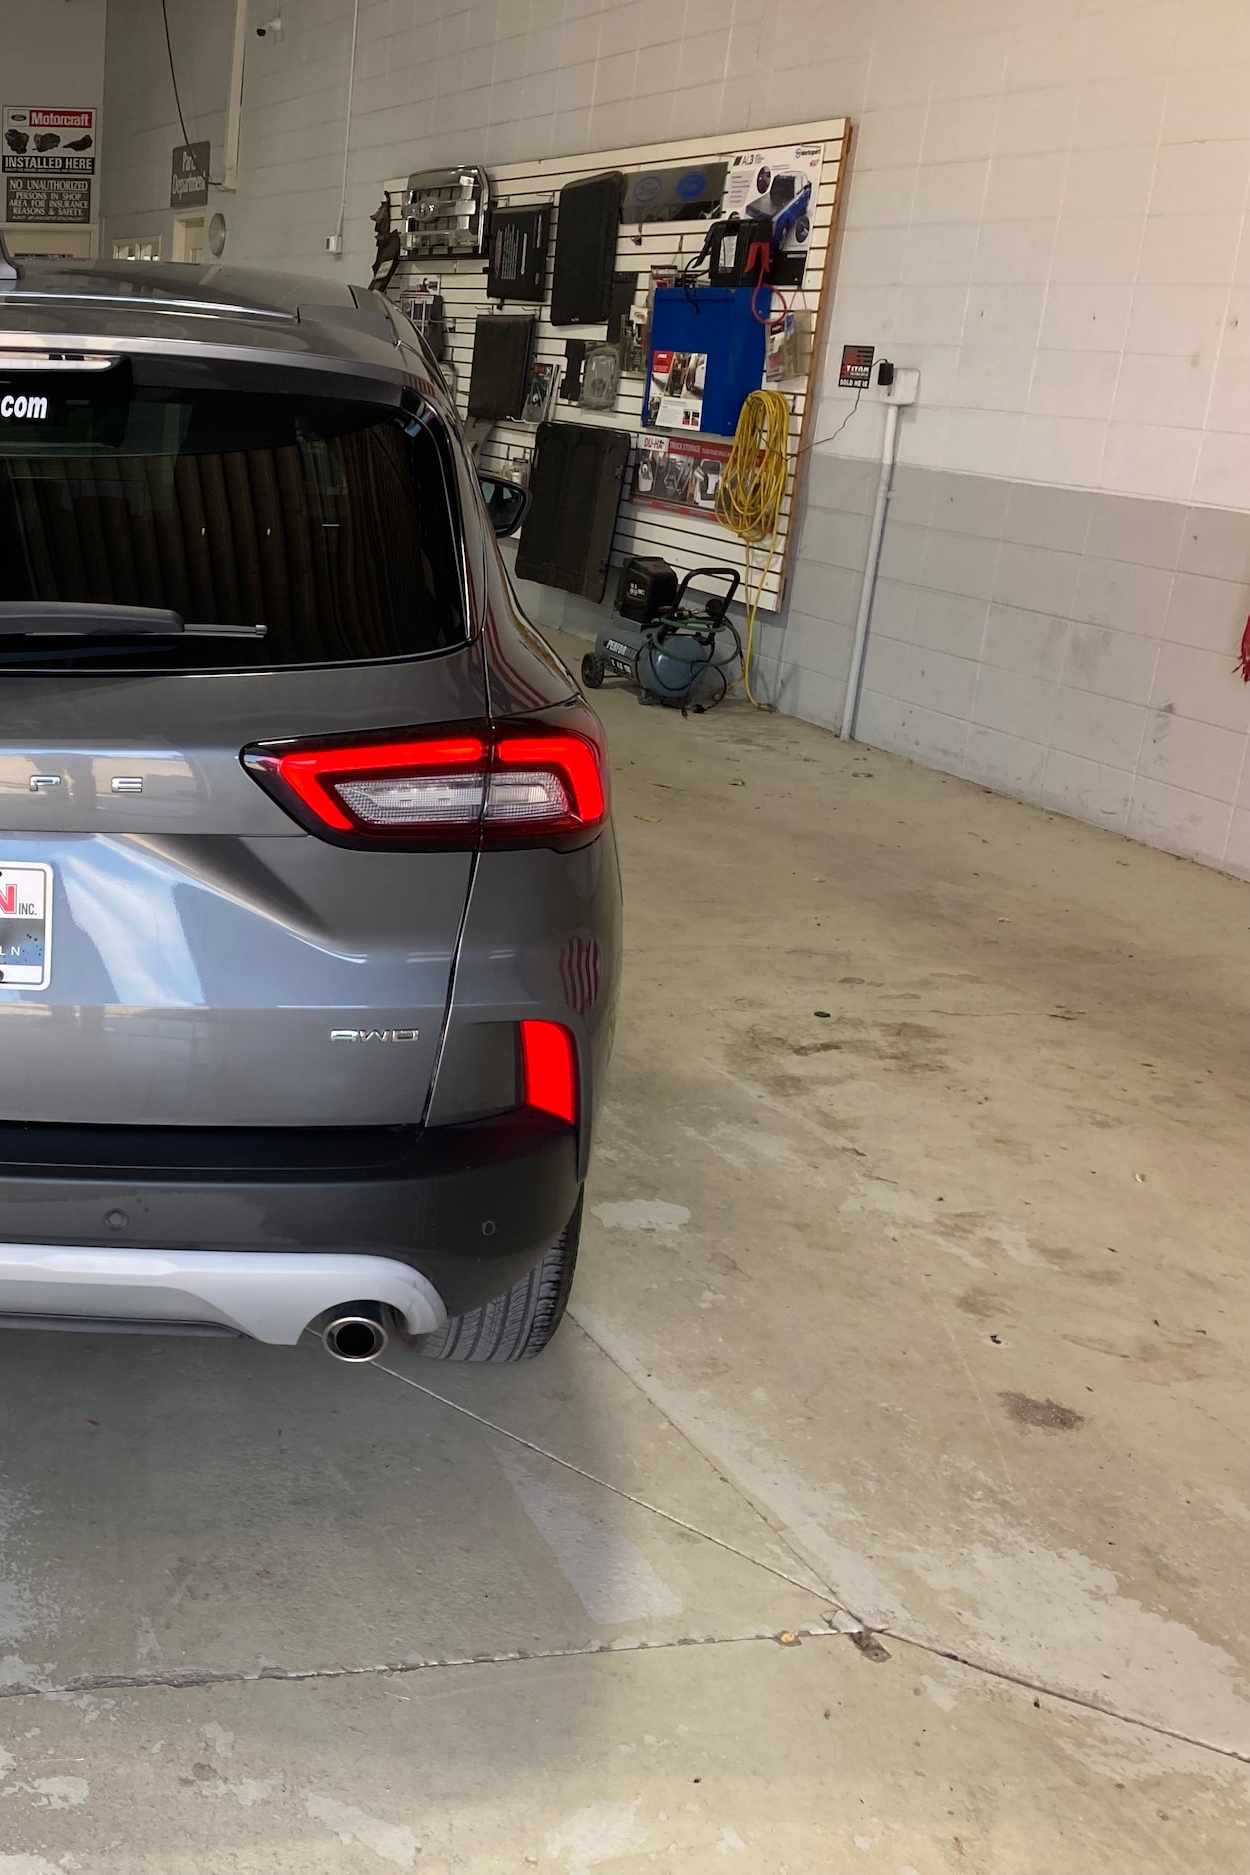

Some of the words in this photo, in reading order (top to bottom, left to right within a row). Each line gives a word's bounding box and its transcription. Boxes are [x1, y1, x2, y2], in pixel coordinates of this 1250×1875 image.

[31, 112, 90, 126] Motorcraft
[4, 156, 62, 168] INSTALLED
[65, 157, 93, 169] HERE
[10, 179, 23, 189] NO
[27, 180, 88, 191] UNAUTHORIZED
[16, 192, 47, 200] PERSONS
[50, 192, 59, 200] IN
[62, 193, 81, 201] SHOP
[9, 199, 28, 207] AREA
[49, 200, 88, 209] INSURANCE
[13, 207, 45, 215] REASONS
[846, 364, 870, 372] TITAN
[839, 378, 854, 386] SOLD
[18, 902, 37, 916] INC.
[330, 1029, 420, 1043] AWD
